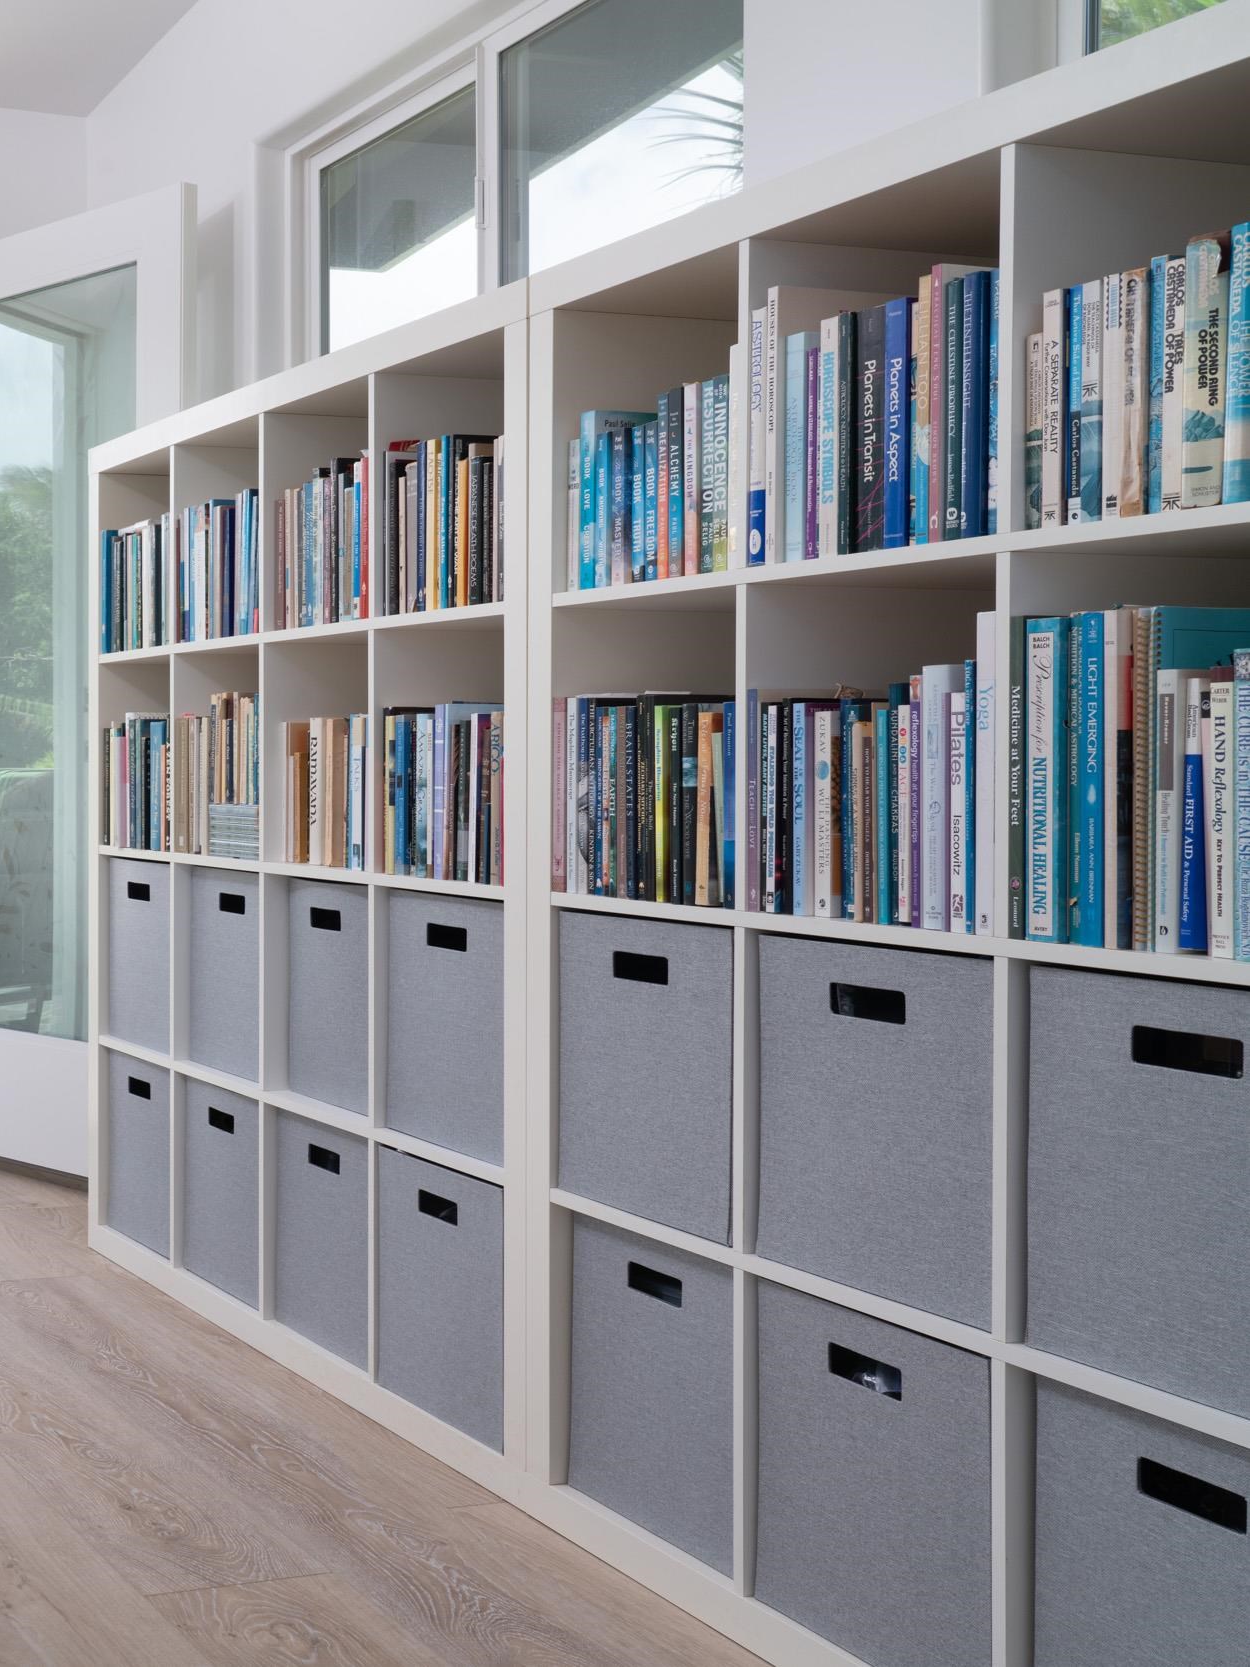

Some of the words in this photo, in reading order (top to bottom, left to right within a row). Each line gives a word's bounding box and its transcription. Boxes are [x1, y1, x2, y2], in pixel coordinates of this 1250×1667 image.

[1175, 263, 1184, 306] CARLOS
[1232, 234, 1242, 315] CASTANEDA
[964, 291, 972, 314] THE
[1073, 295, 1081, 311] The
[1165, 266, 1175, 330] CASTANEDA
[918, 300, 928, 365] LILLIAN
[964, 315, 972, 355] TENTH
[1072, 314, 1080, 340] Active
[1198, 330, 1208, 345] OF
[1208, 308, 1219, 329] THE
[769, 340, 775, 353] OF
[1051, 340, 1059, 349] A
[1072, 344, 1080, 362] Side
[1165, 333, 1174, 350] OF
[1174, 332, 1183, 365] TALES
[1208, 331, 1218, 375] SECOND
[750, 320, 762, 413] ASTROLOGY
[888, 358, 902, 411] Planets
[963, 359, 971, 408] INSIGHT
[1050, 355, 1059, 405] SEPARATE
[1072, 366, 1079, 375] of
[1165, 352, 1174, 393] POWER
[1198, 347, 1208, 389] POWER
[767, 377, 775, 434] HOROSCOPE
[822, 352, 835, 432] HOROSCOPE
[864, 360, 877, 416] Planets
[918, 372, 928, 409] TOO
[1071, 377, 1079, 410] Infinity
[1208, 376, 1218, 406] RING
[864, 419, 876, 432] in
[890, 414, 900, 429] in
[948, 384, 956, 437] PROPHECY
[702, 388, 713, 513] RESURRECTION
[1049, 411, 1058, 454] REALITY
[1071, 419, 1080, 447] Carlos
[659, 432, 667, 502] REALIZATION
[670, 445, 679, 496] ALCHEMY
[714, 402, 726, 512] INNOCENCE
[822, 439, 834, 504] SYMBOLS
[863, 433, 876, 482] Transit
[887, 433, 900, 482] Aspect
[1070, 449, 1080, 496] Castaneda
[614, 476, 622, 503] BOOK
[633, 475, 641, 504] BOOK
[646, 468, 654, 497] BOOK
[633, 519, 641, 552] TRUTH
[646, 510, 654, 560] FREEDOM
[1031, 655, 1052, 734] Prescription
[1087, 657, 1098, 697] LIGHT
[977, 686, 993, 730] Yoga
[1012, 686, 1020, 745] Medicine
[1238, 686, 1250, 712] THE
[794, 727, 804, 764] SEAT
[951, 711, 965, 785] Pilates
[1031, 734, 1048, 753] for
[1087, 702, 1098, 773] EMERGING
[1215, 716, 1225, 762] HAND
[1238, 716, 1250, 751] CURE
[1012, 748, 1020, 760] at
[1238, 756, 1250, 767] is
[1011, 763, 1021, 797] Your
[1238, 771, 1250, 782] in
[794, 783, 804, 824] SOUL
[818, 788, 824, 807] WU
[819, 810, 824, 820] LI
[891, 789, 899, 834] CHAKRAS
[1011, 799, 1020, 826] Feet
[1032, 757, 1047, 850] NUTRITIONAL
[1185, 799, 1195, 833] FIRST
[1212, 767, 1227, 835] Reflexology
[1238, 787, 1250, 812] THE
[953, 815, 962, 876] Isacowitz
[1184, 836, 1193, 859] AID
[1217, 854, 1222, 863] TO
[1238, 817, 1250, 861] CAUSE
[1033, 852, 1047, 914] HEALING
[1241, 866, 1250, 877] Dr.
[1241, 878, 1250, 895] Ruza
[1181, 901, 1189, 922] Safety
